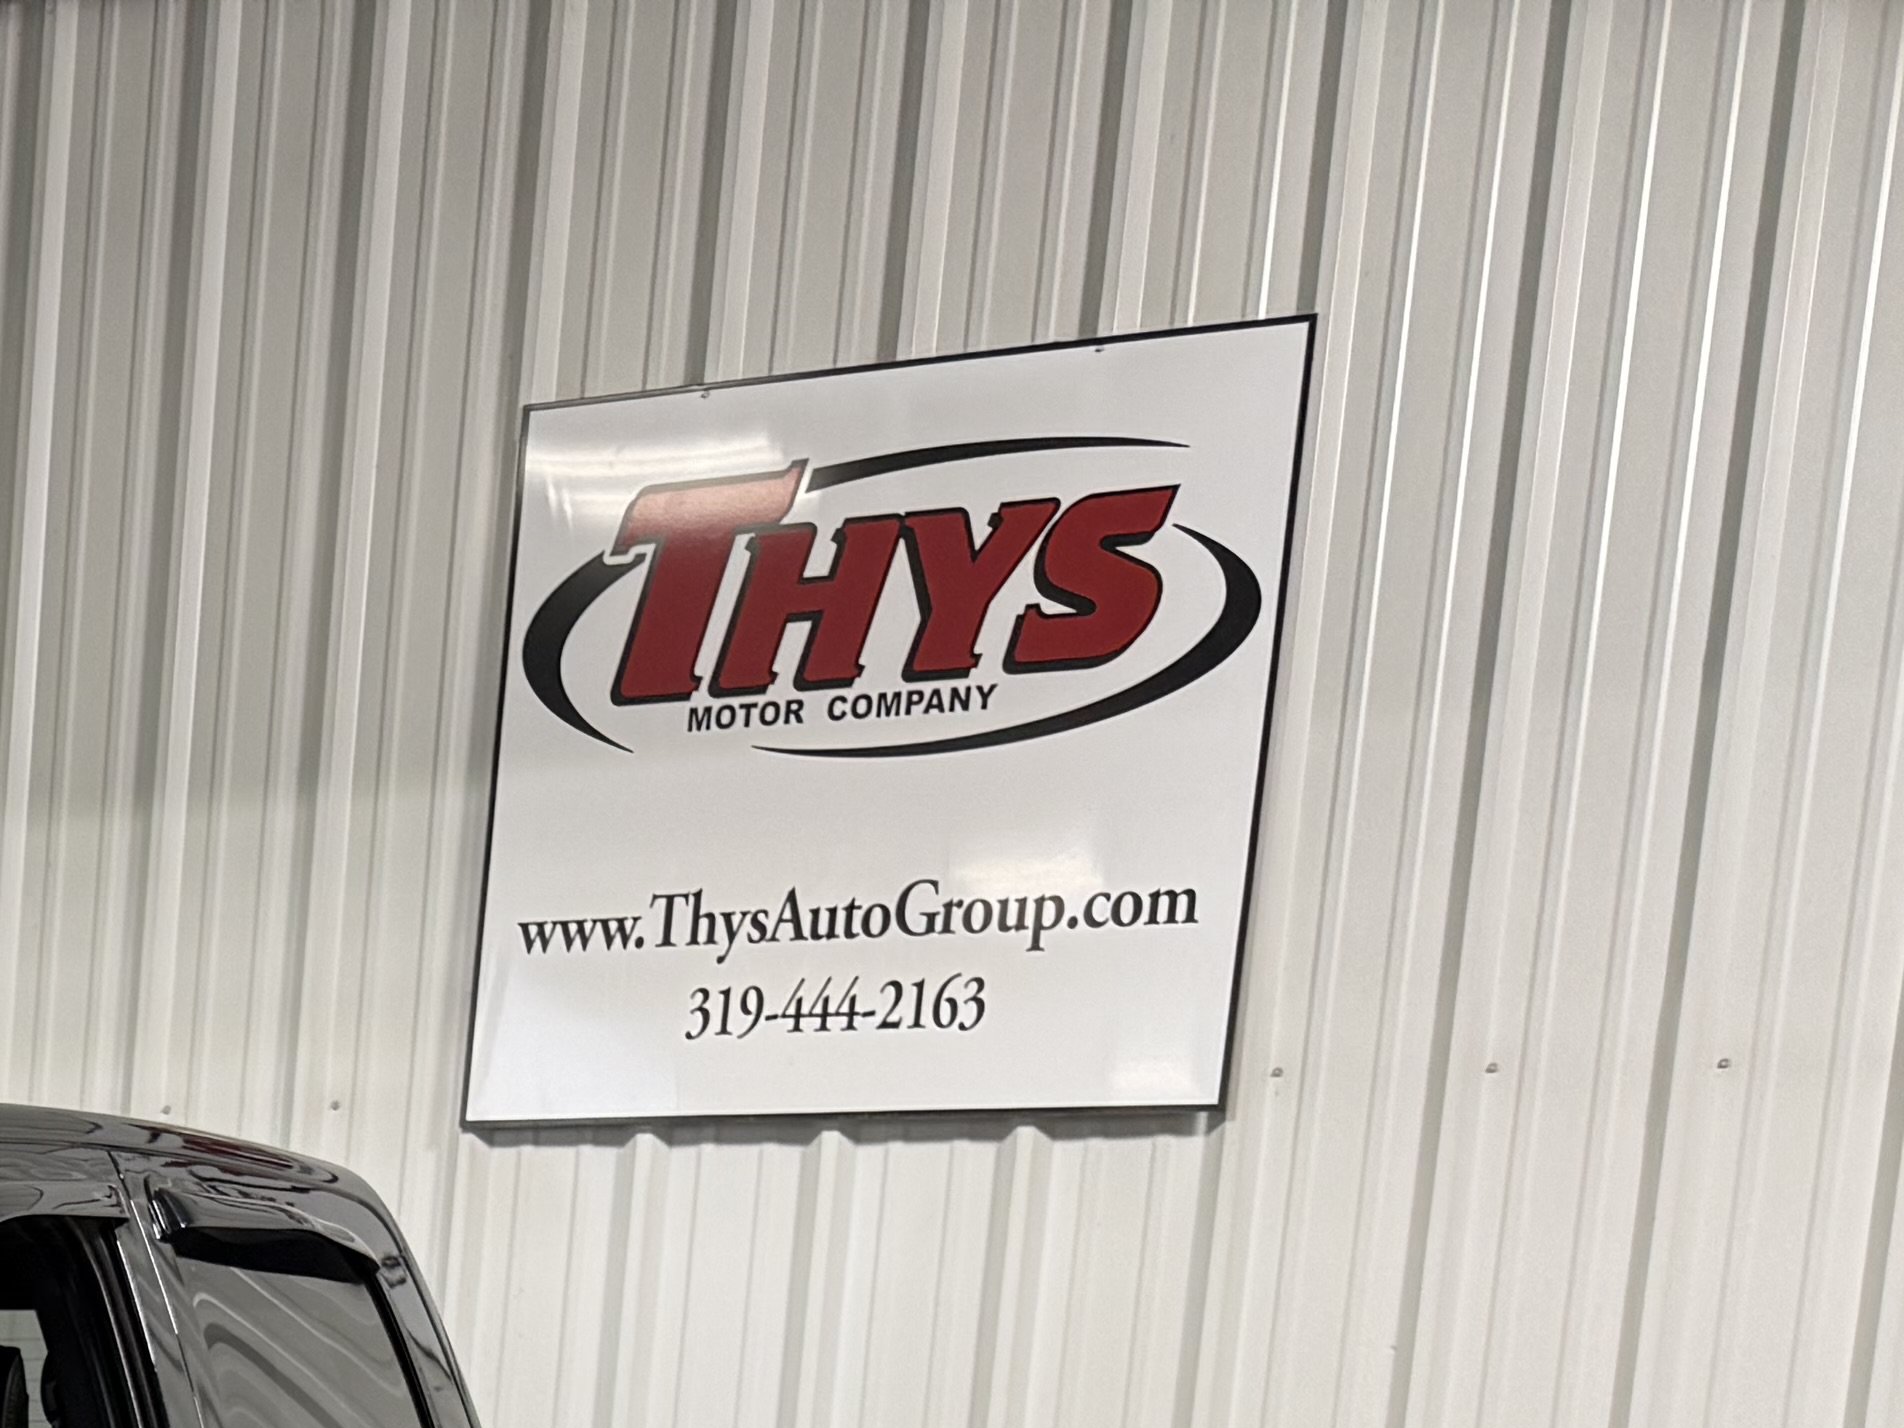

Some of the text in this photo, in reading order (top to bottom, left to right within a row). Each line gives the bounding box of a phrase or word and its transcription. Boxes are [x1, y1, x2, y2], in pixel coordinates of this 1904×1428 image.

[607, 459, 1180, 706] THYS
[687, 684, 998, 732] MOTOR COMPANY
[518, 879, 1199, 965] www.ThysAutoGroup.com
[685, 973, 987, 1040] 319-444-2163
